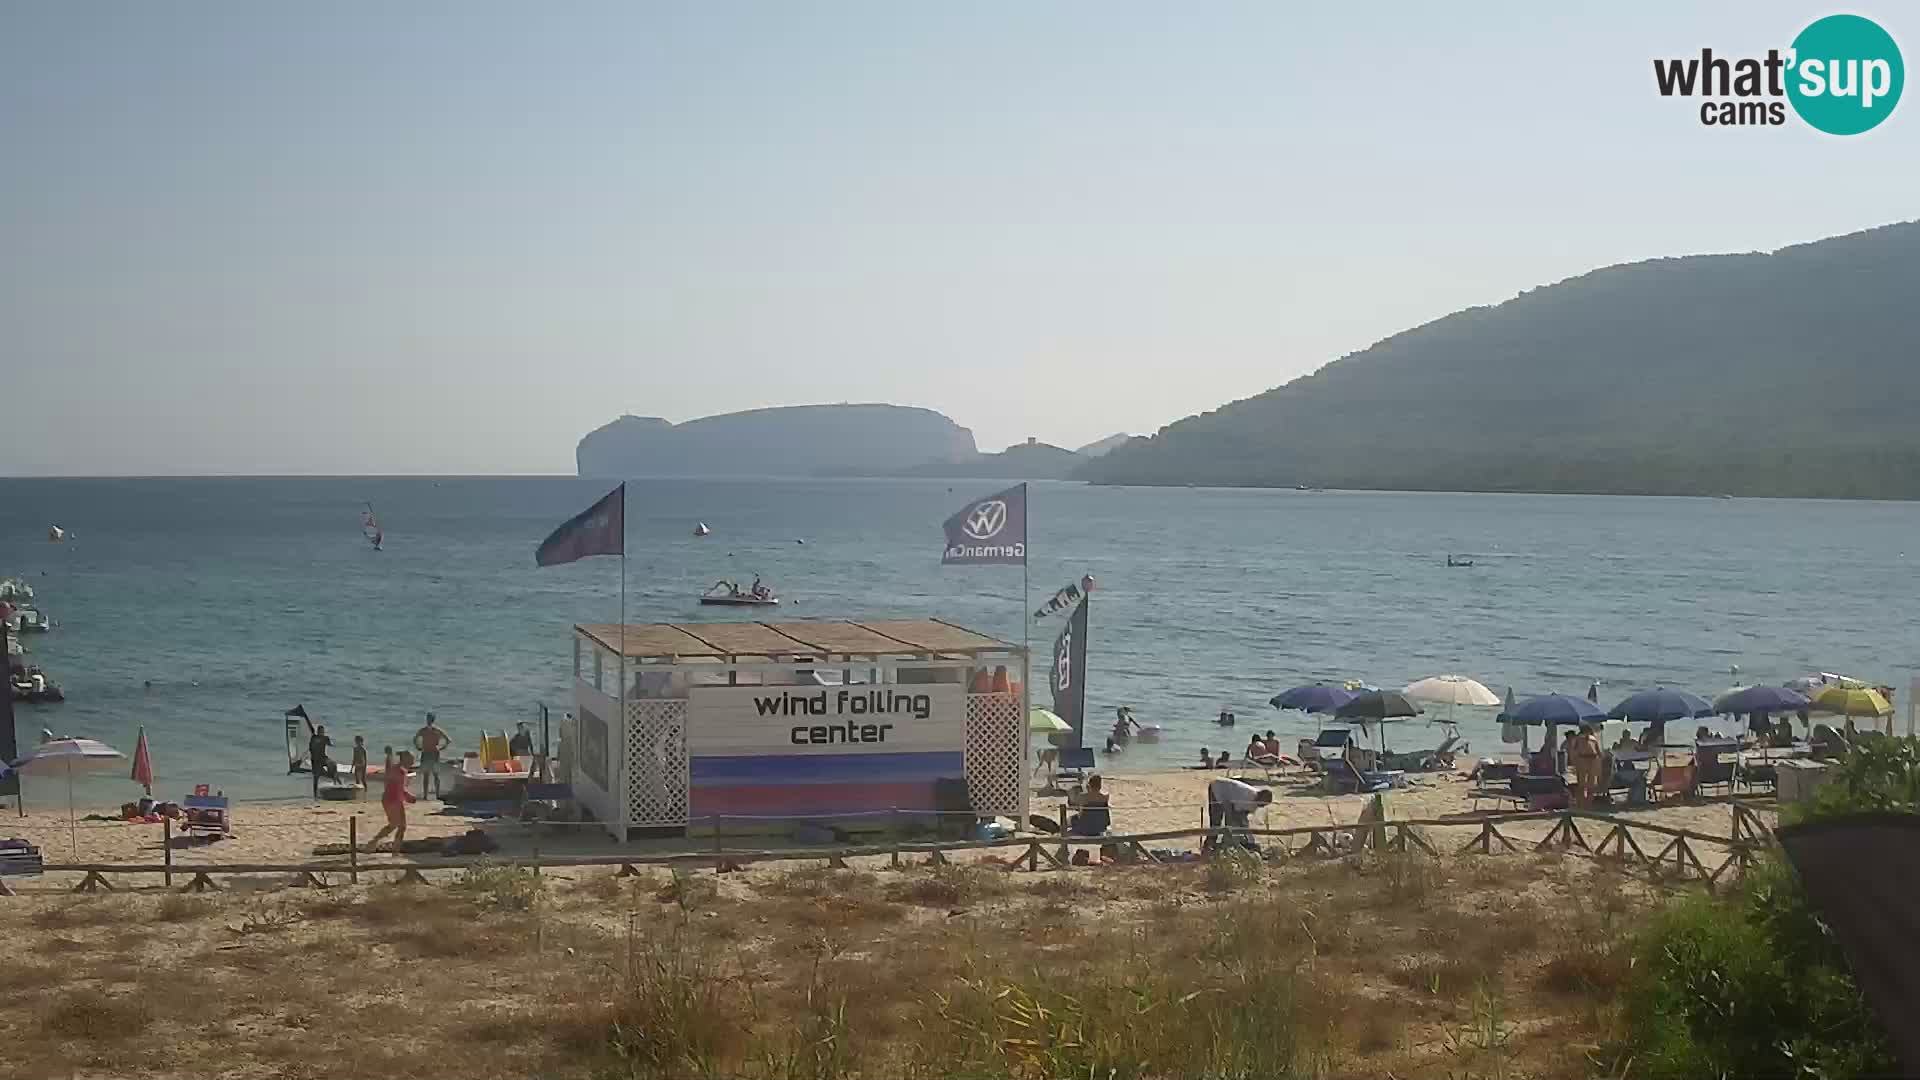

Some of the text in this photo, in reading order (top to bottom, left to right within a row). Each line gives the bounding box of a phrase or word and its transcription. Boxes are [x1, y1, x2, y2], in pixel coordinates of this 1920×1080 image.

[754, 690, 931, 722] wind foiling
[791, 723, 894, 745] center
